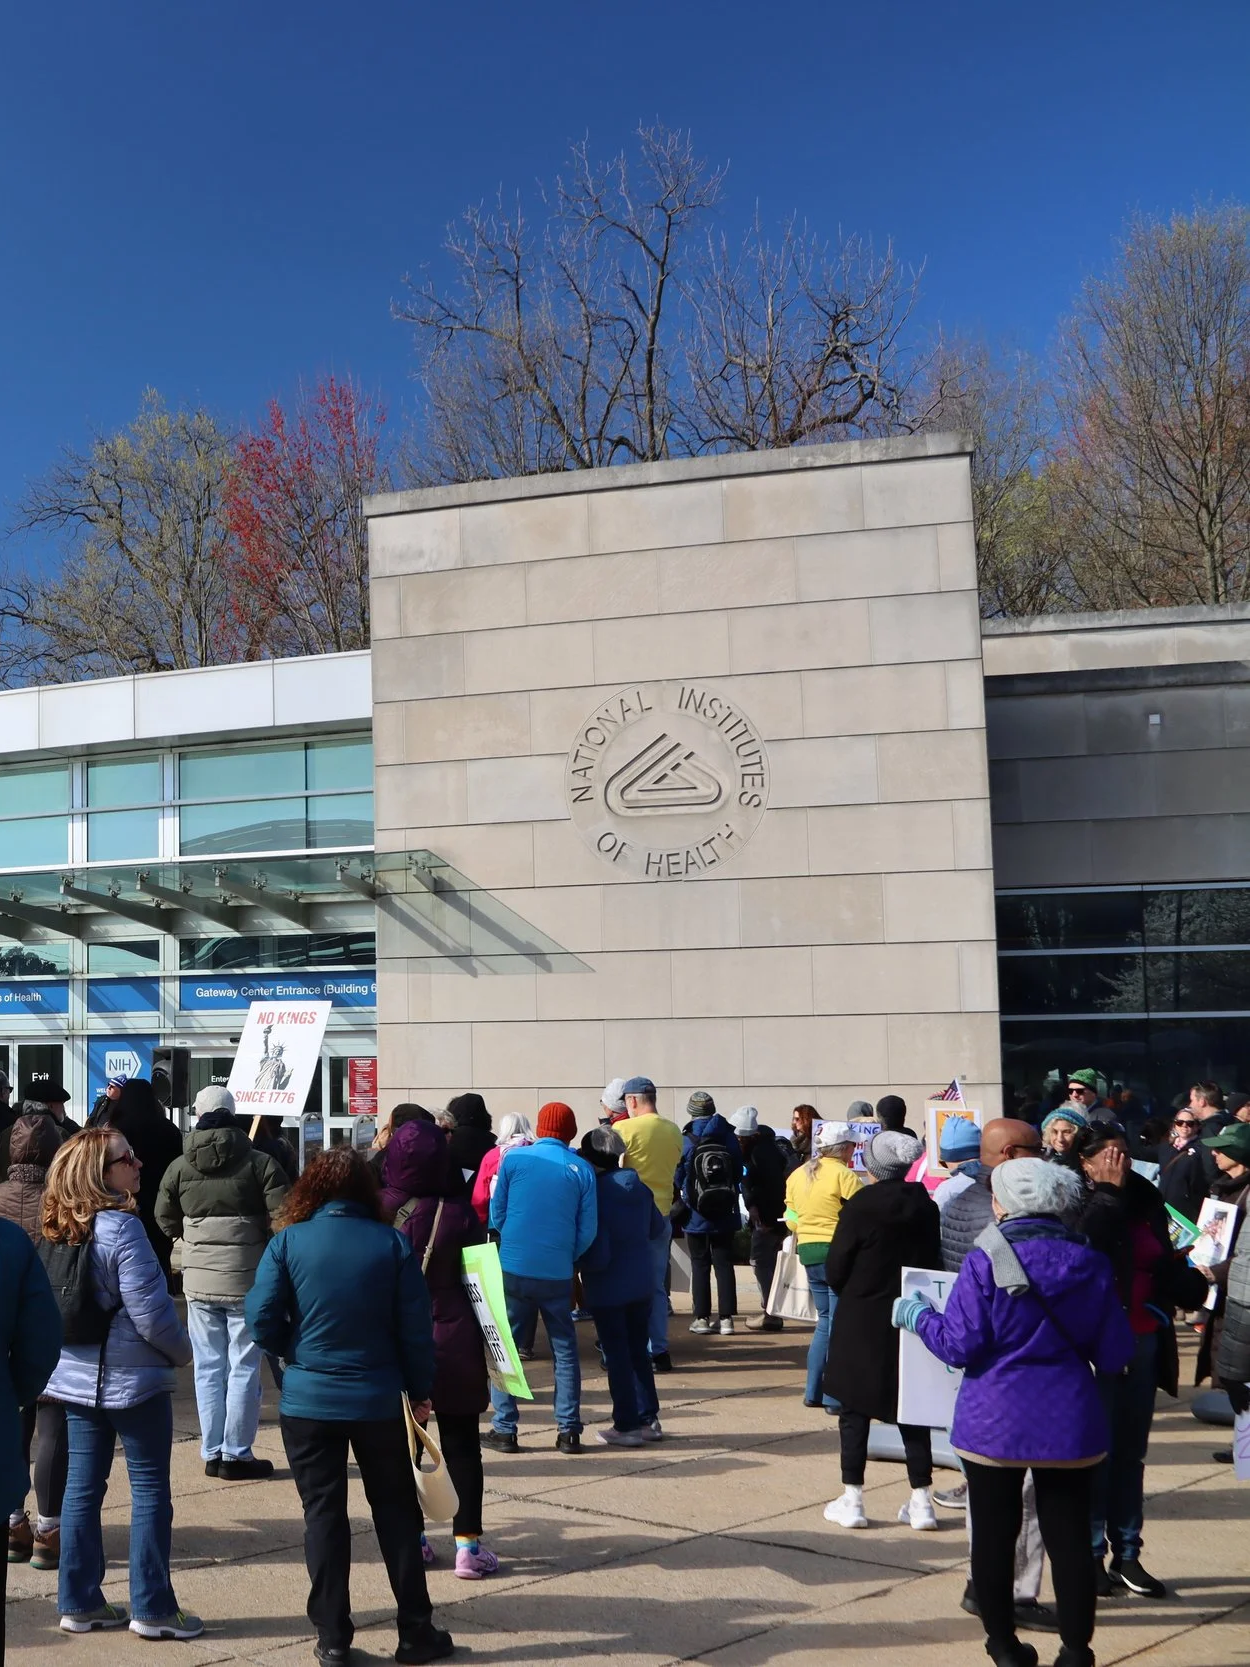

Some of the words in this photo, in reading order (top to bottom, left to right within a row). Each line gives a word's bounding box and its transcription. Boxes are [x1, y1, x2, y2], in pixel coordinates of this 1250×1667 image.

[571, 690, 653, 804] NATIONAL
[677, 686, 765, 809] INSTITUTES
[597, 831, 635, 862] OF
[644, 823, 743, 877] HEALTH
[4, 993, 13, 1002] of
[14, 992, 42, 1002] Health
[196, 987, 238, 999] Gateway
[240, 986, 273, 997] Center
[276, 985, 321, 996] Entrance
[323, 983, 368, 996] (Building
[257, 1011, 275, 1025] NO
[108, 1058, 132, 1071] NIH
[235, 1090, 267, 1103] SINCE
[268, 1091, 296, 1104] 1776
